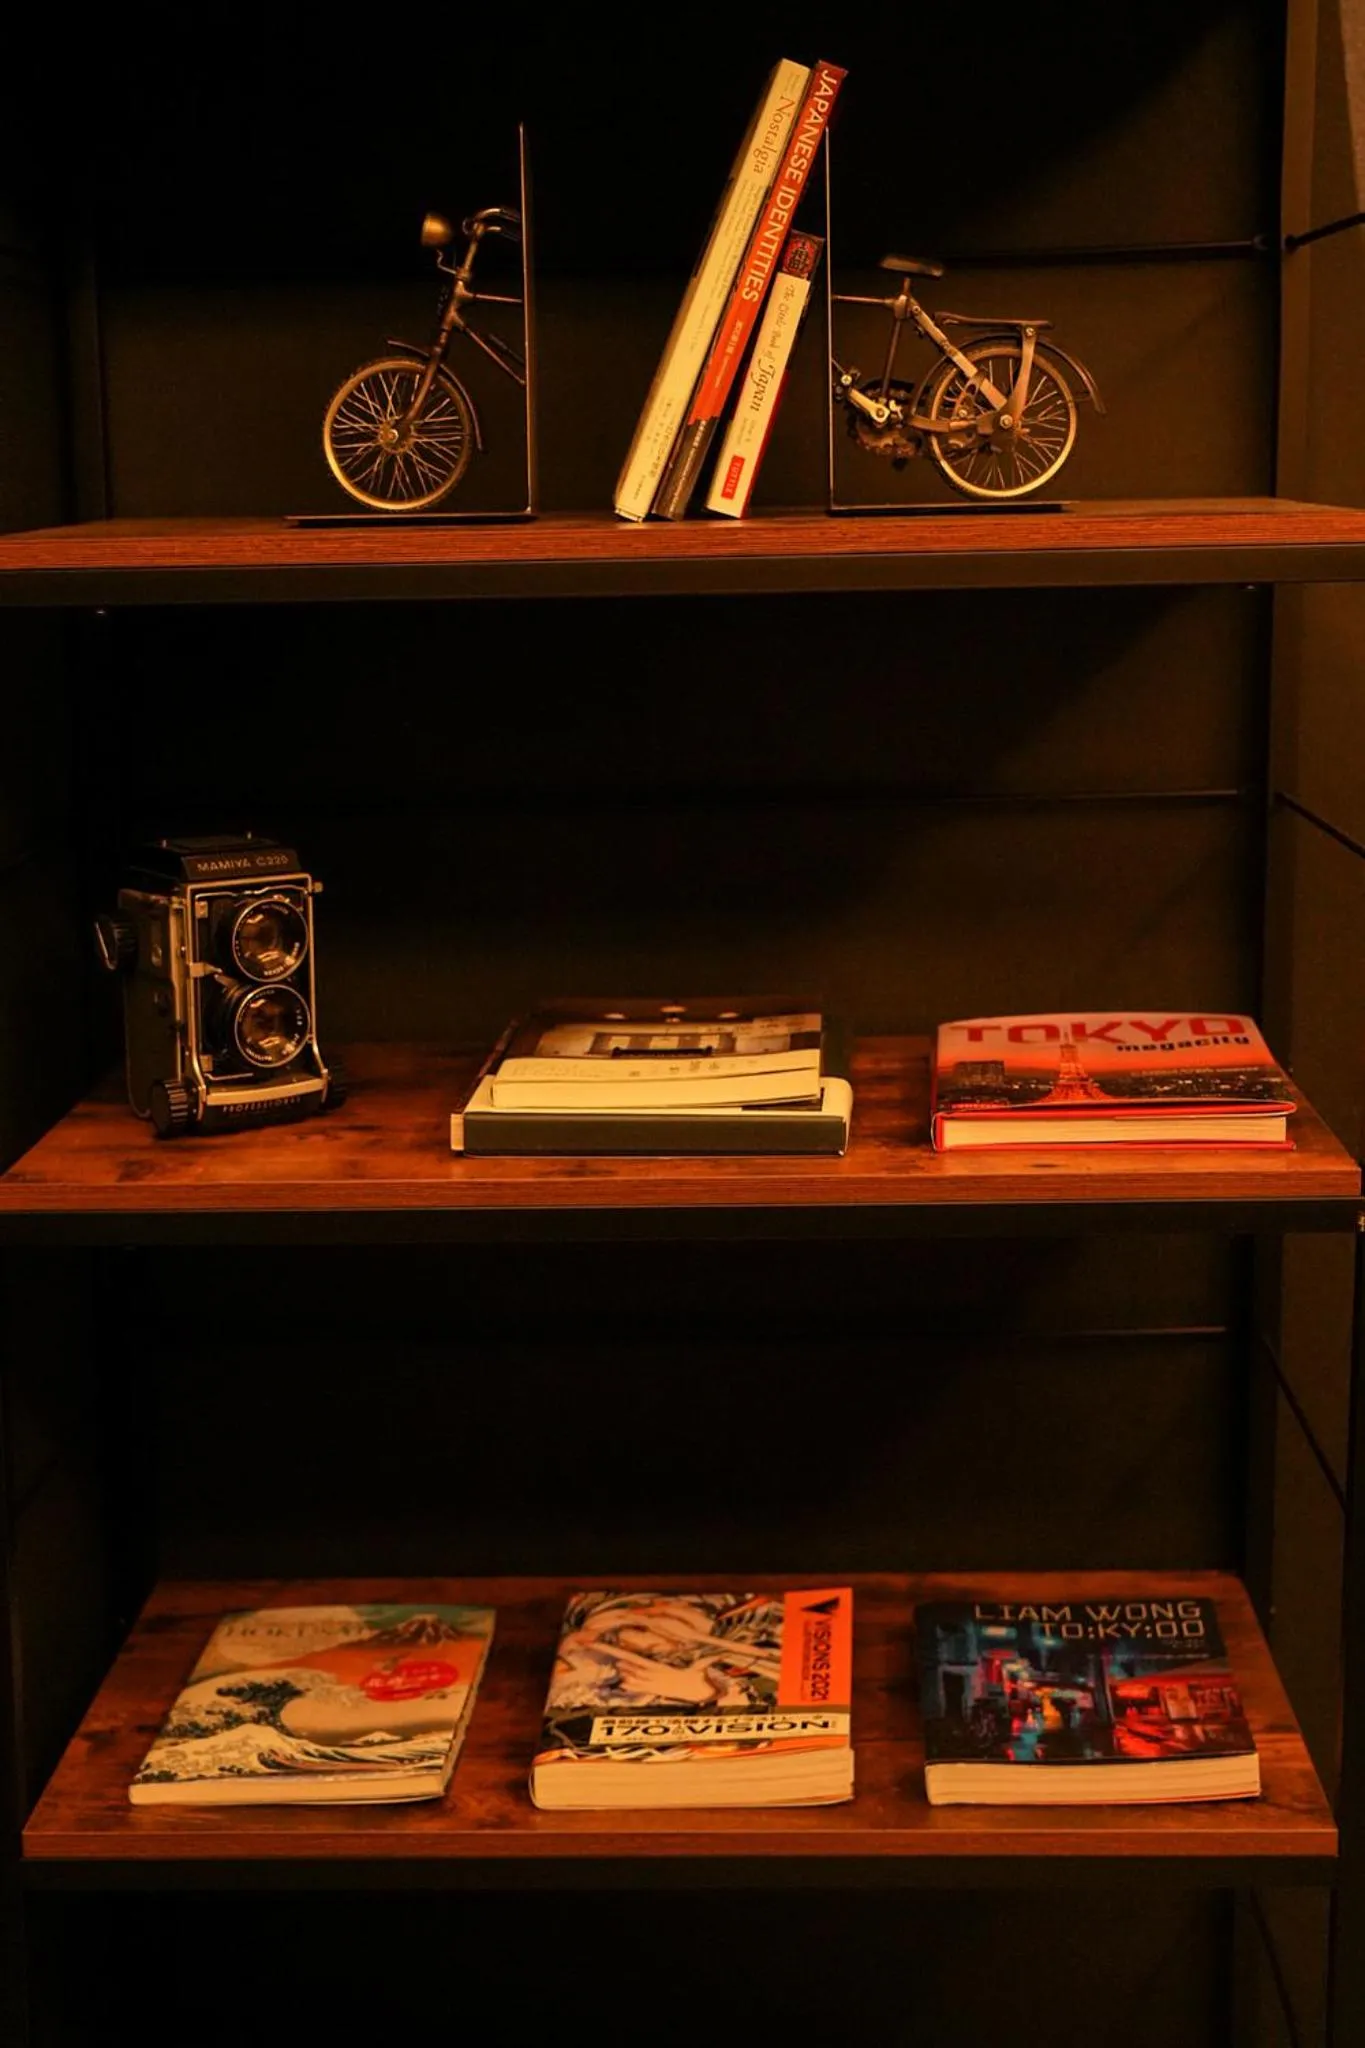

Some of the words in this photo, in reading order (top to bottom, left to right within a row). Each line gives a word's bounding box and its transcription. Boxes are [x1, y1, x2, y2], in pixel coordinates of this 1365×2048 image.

[753, 96, 796, 174] Nostalgia
[784, 69, 838, 184] JAPANESE
[742, 185, 797, 303] IDENTITIES
[750, 358, 776, 412] Japan
[196, 857, 252, 873] MAMIYA
[950, 1017, 1247, 1044] TOKYO
[1116, 1036, 1250, 1051] megacity
[975, 1603, 1072, 1621] LIAM
[1085, 1601, 1201, 1621] WONG
[812, 1616, 832, 1670] VISIONS
[811, 1672, 830, 1701] 2021
[602, 1724, 671, 1737] 170
[686, 1719, 830, 1735] VISION
